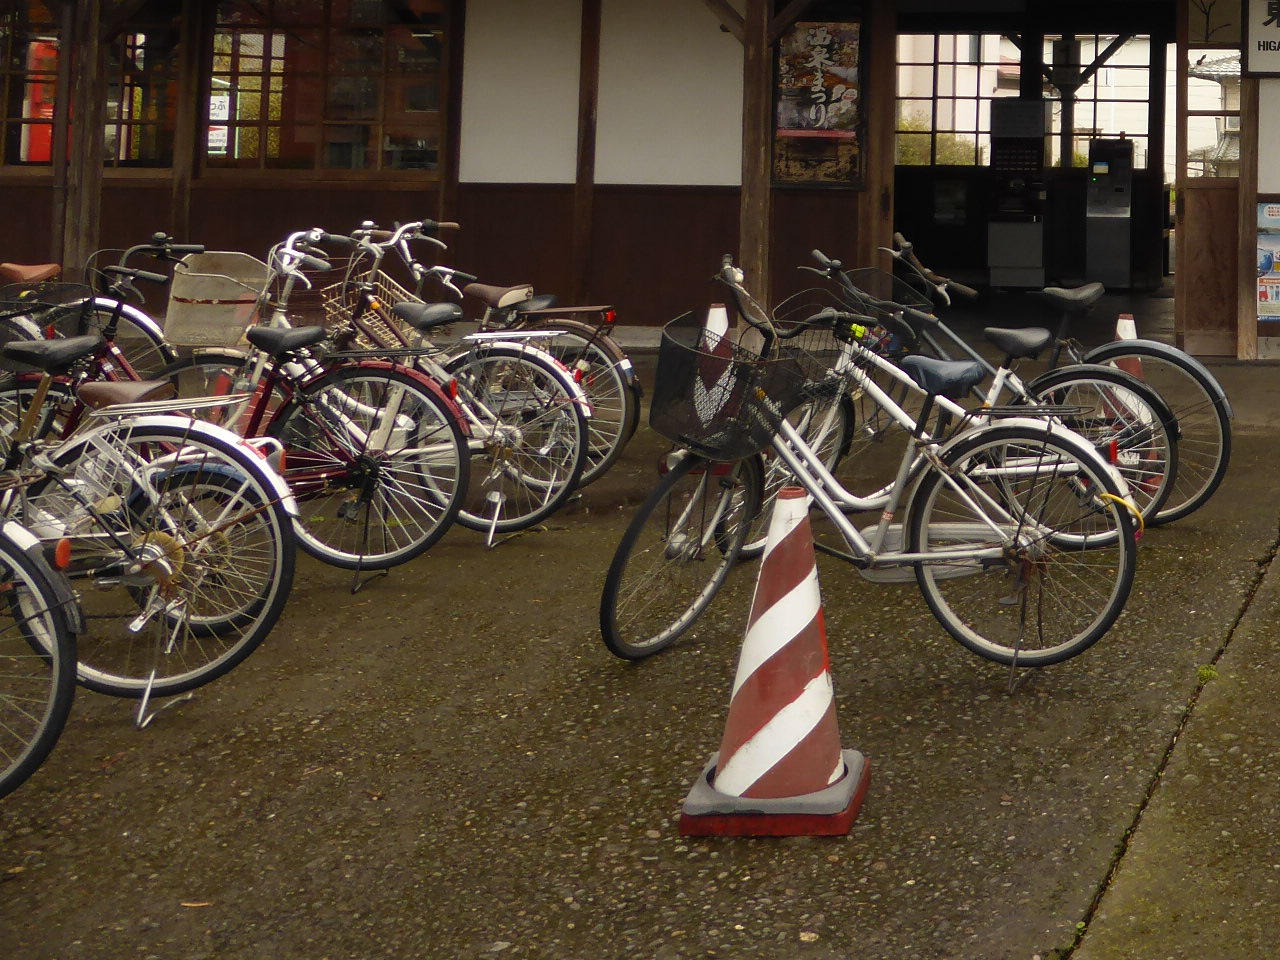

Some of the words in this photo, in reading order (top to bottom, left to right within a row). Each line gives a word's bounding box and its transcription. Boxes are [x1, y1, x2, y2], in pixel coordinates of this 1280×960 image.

[803, 26, 835, 128] 温泉まつり
